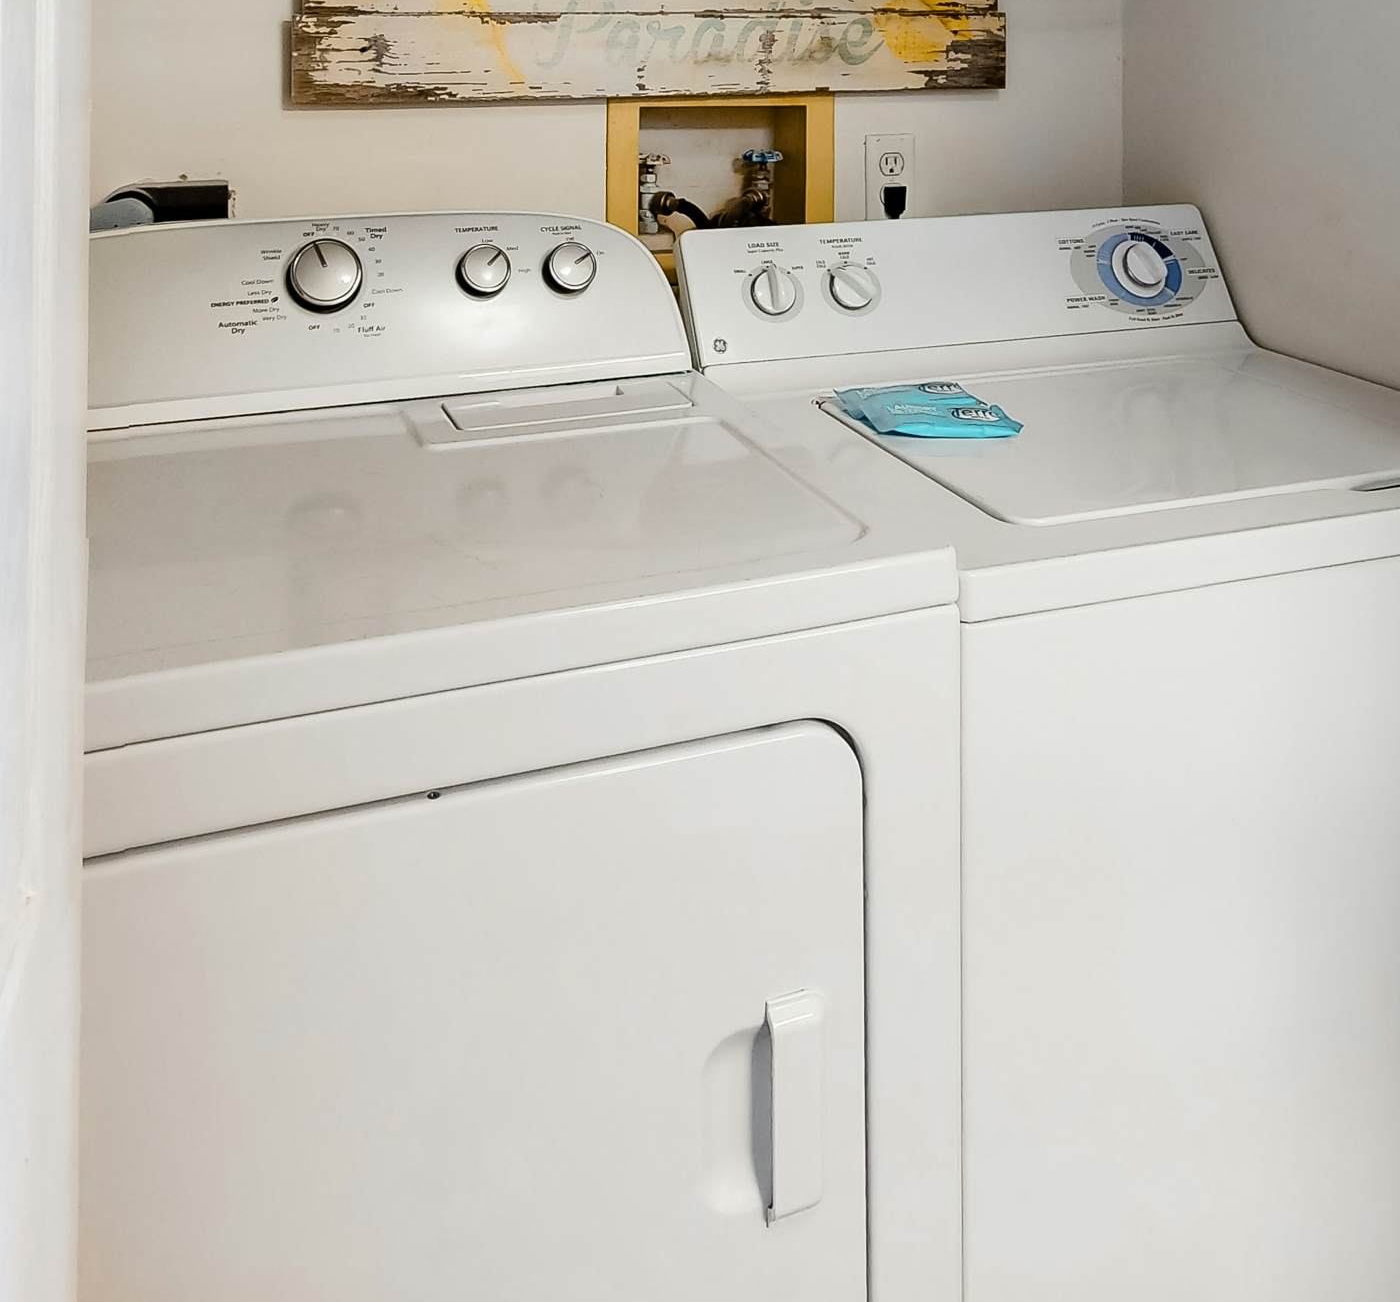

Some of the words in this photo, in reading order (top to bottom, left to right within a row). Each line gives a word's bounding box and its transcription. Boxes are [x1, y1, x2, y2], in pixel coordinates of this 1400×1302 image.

[454, 226, 500, 234] TEMPERATURE
[218, 320, 258, 329] Automatic
[231, 327, 246, 335] Dry
[357, 325, 374, 333] Fluff
